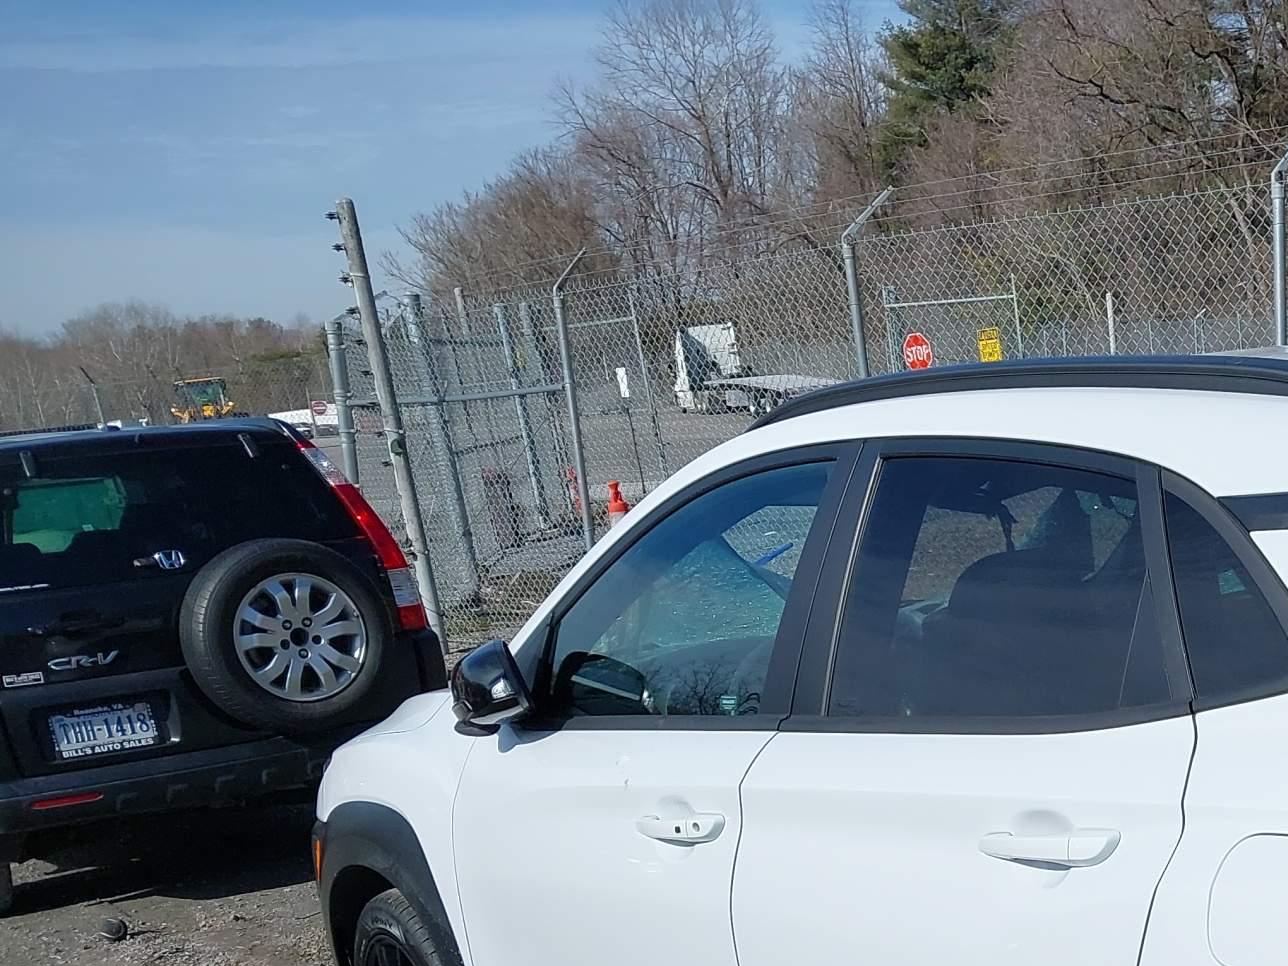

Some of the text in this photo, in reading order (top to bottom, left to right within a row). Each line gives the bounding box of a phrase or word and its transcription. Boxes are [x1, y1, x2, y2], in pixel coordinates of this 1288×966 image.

[905, 344, 930, 363] STOP
[47, 650, 119, 671] CR-V
[62, 738, 154, 759] BILL'S AUTO SALES
